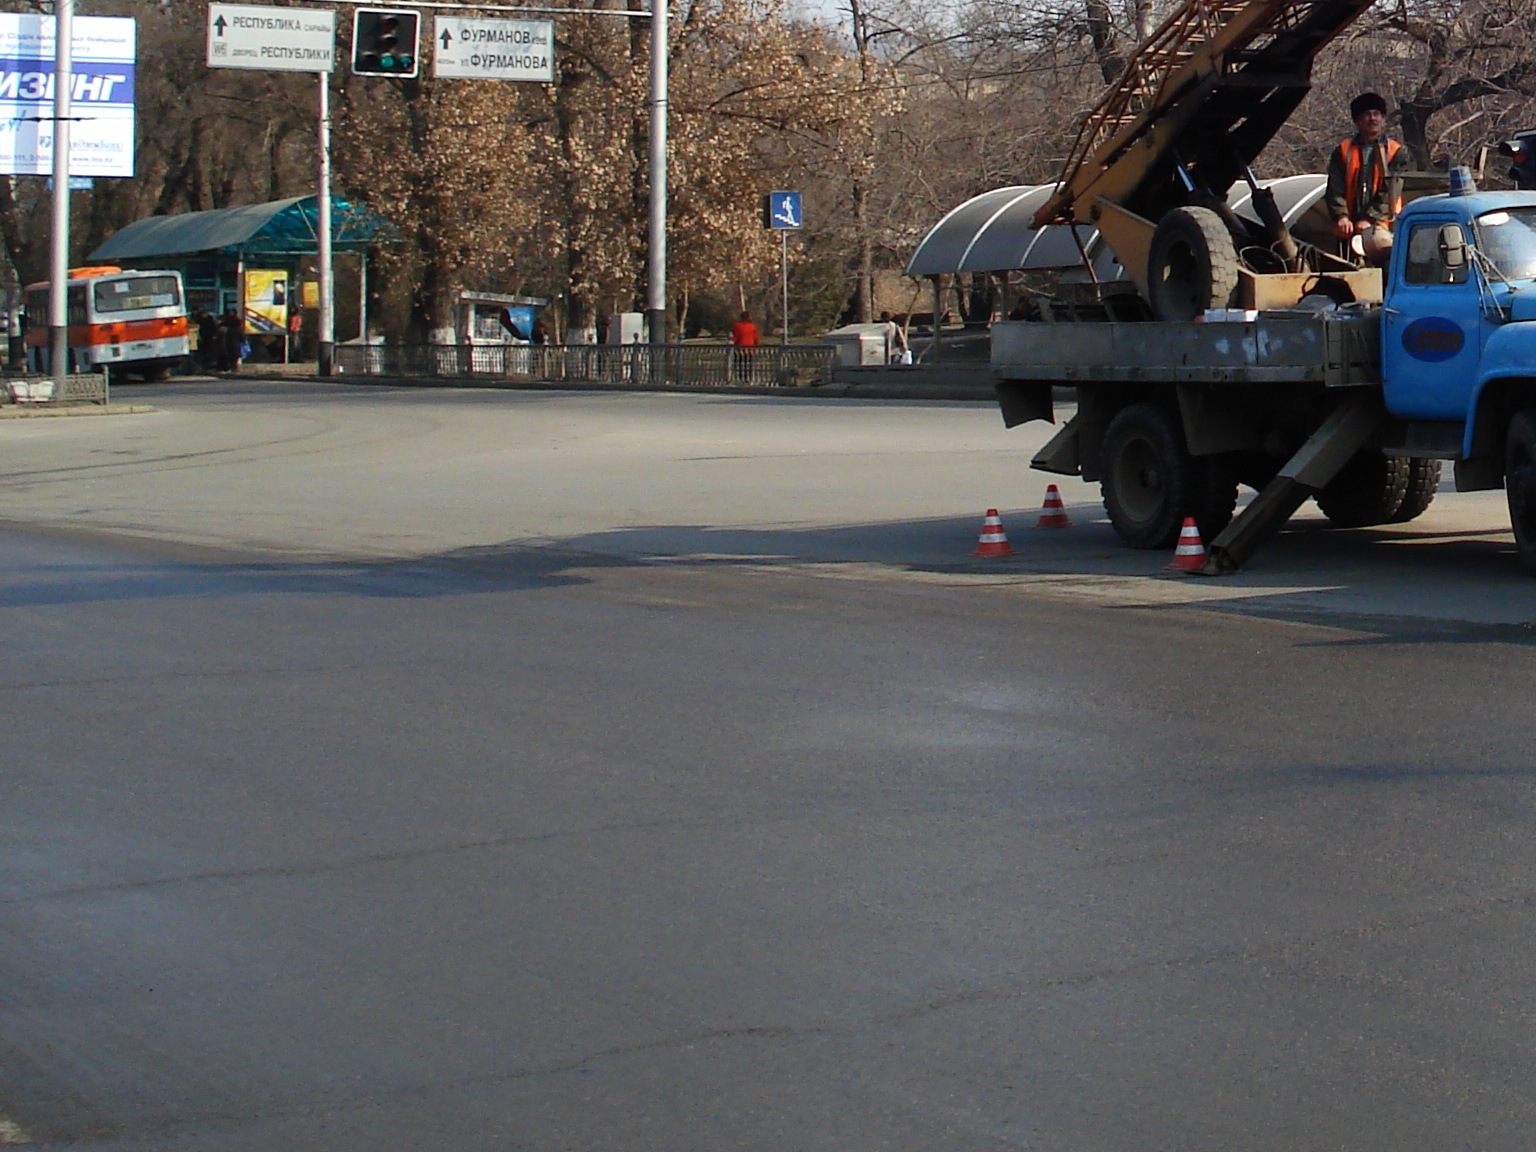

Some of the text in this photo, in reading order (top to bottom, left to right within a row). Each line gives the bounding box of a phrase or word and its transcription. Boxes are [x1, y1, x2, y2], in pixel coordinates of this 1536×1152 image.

[233, 16, 301, 31] РЕСПУБЛИКА
[461, 29, 530, 45] ФУРМАНОВ
[261, 46, 330, 60] РЕСПУБЛИКИ
[470, 53, 548, 69] ФУРМАНОВА
